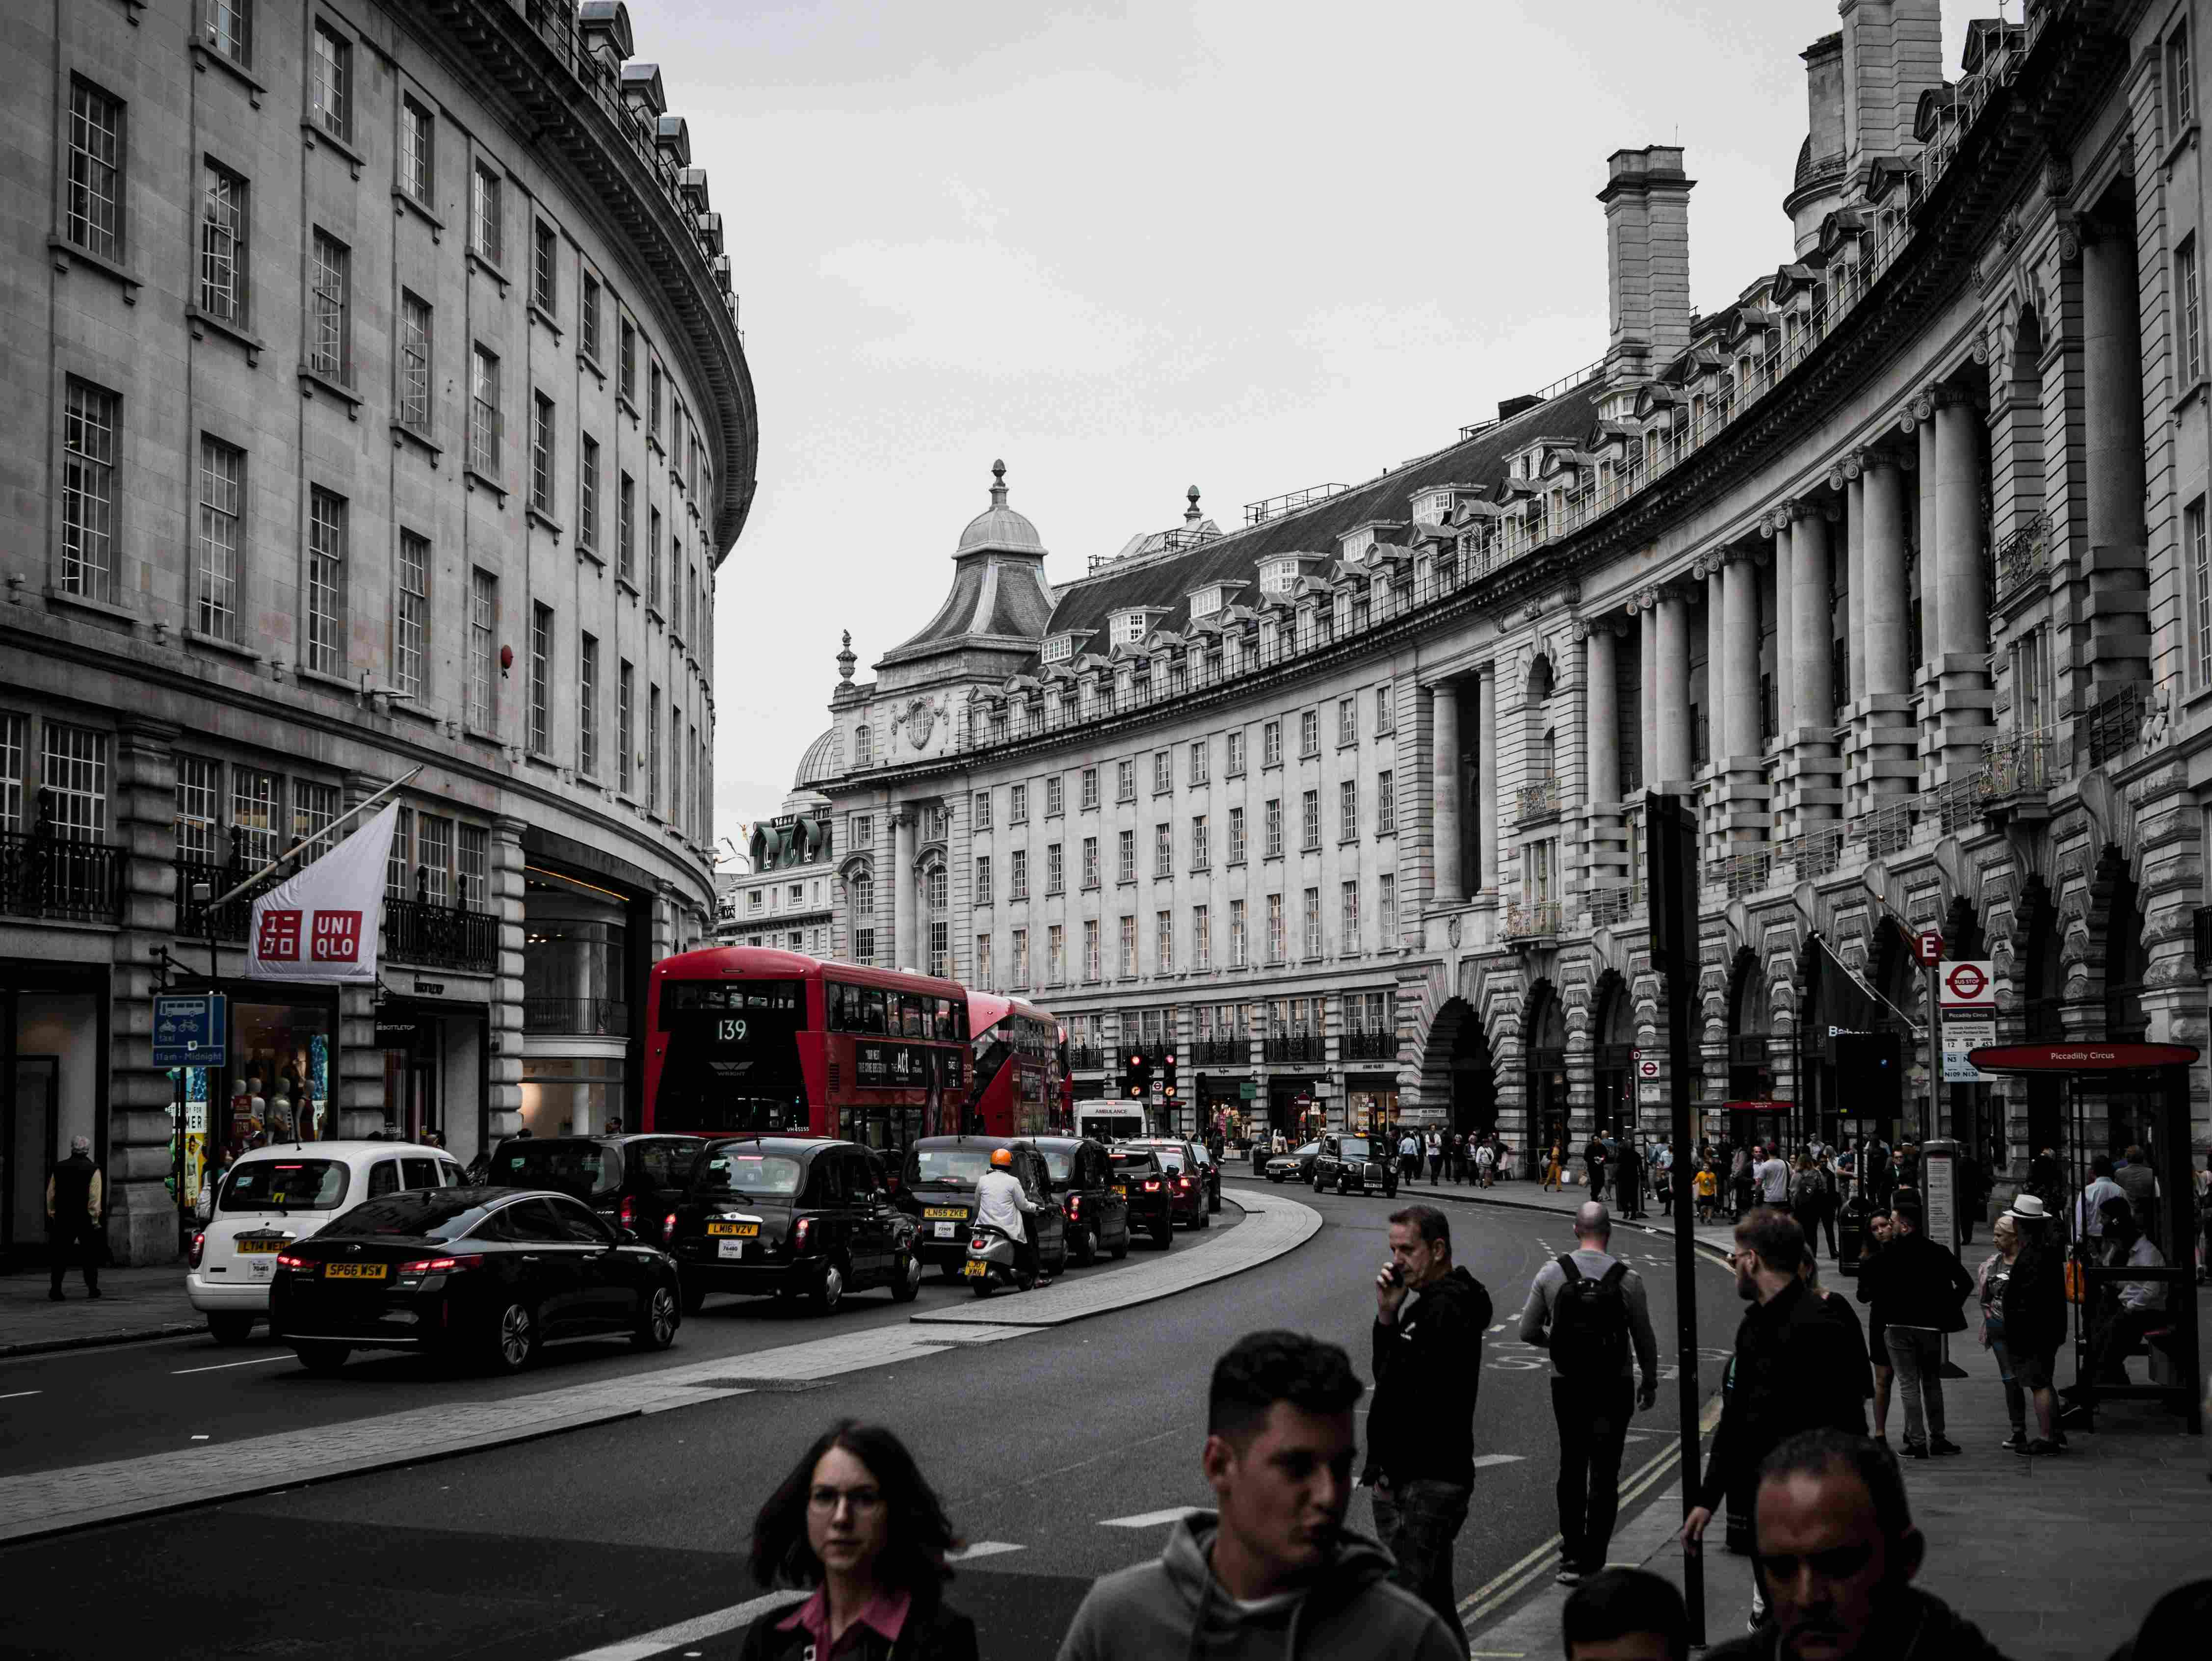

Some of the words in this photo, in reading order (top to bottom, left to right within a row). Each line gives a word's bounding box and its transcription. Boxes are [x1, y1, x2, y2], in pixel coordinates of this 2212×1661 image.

[317, 916, 353, 934] UNI
[316, 938, 354, 958] QLO
[1922, 937, 1937, 957] E
[719, 1019, 746, 1040] 139
[184, 1052, 224, 1062] Midnight
[2051, 1052, 2089, 1060] Piccadilly
[927, 1209, 948, 1217] LN55
[949, 1209, 964, 1217] ZKE
[713, 1224, 733, 1233] LM16
[736, 1224, 753, 1234] VZV
[329, 1264, 358, 1276] SP66
